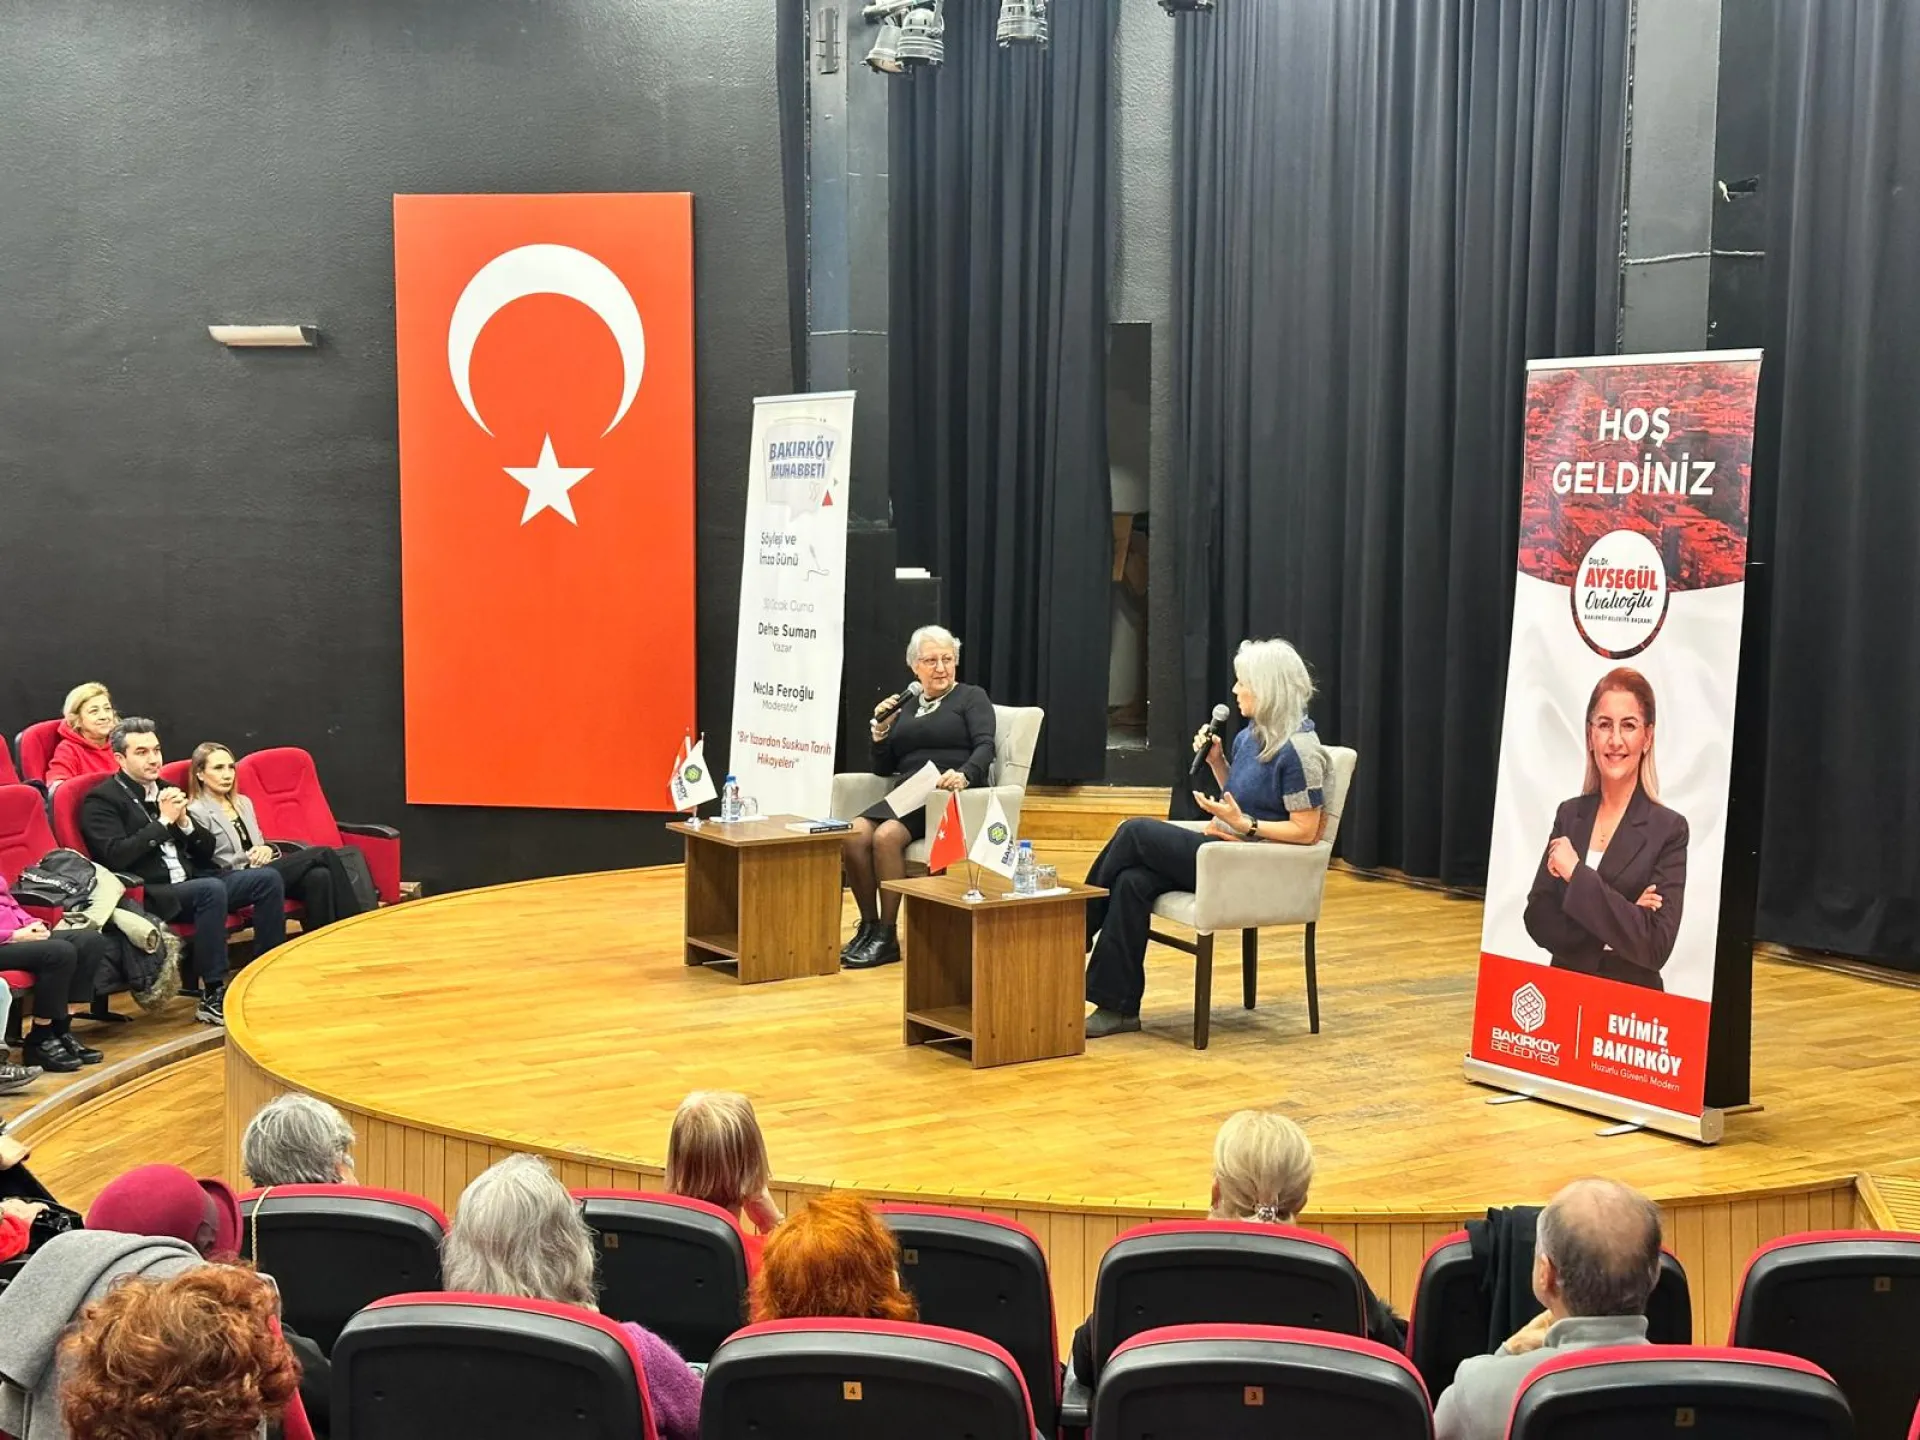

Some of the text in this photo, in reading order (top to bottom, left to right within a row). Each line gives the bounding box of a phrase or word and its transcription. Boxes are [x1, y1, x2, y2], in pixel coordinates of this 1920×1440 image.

[1599, 407, 1671, 448] HOŞ
[769, 435, 834, 460] BAKIRKÖY
[770, 459, 825, 479] MUHABBETİ
[1552, 452, 1716, 495] GELDİNİZ
[785, 534, 797, 546] ve
[1584, 565, 1658, 593] AYŞEGÜL
[1585, 589, 1653, 617] Ovalıoğlu
[781, 623, 817, 640] Suman
[772, 640, 792, 653] Yazar
[777, 684, 815, 702] Feroğlu
[781, 737, 810, 752] Suskun
[1607, 1011, 1669, 1047] EVİMİZ
[1592, 1035, 1683, 1077] BAKIRKÖY
[1590, 1060, 1681, 1092] Huzurlu Güvenli Modern
